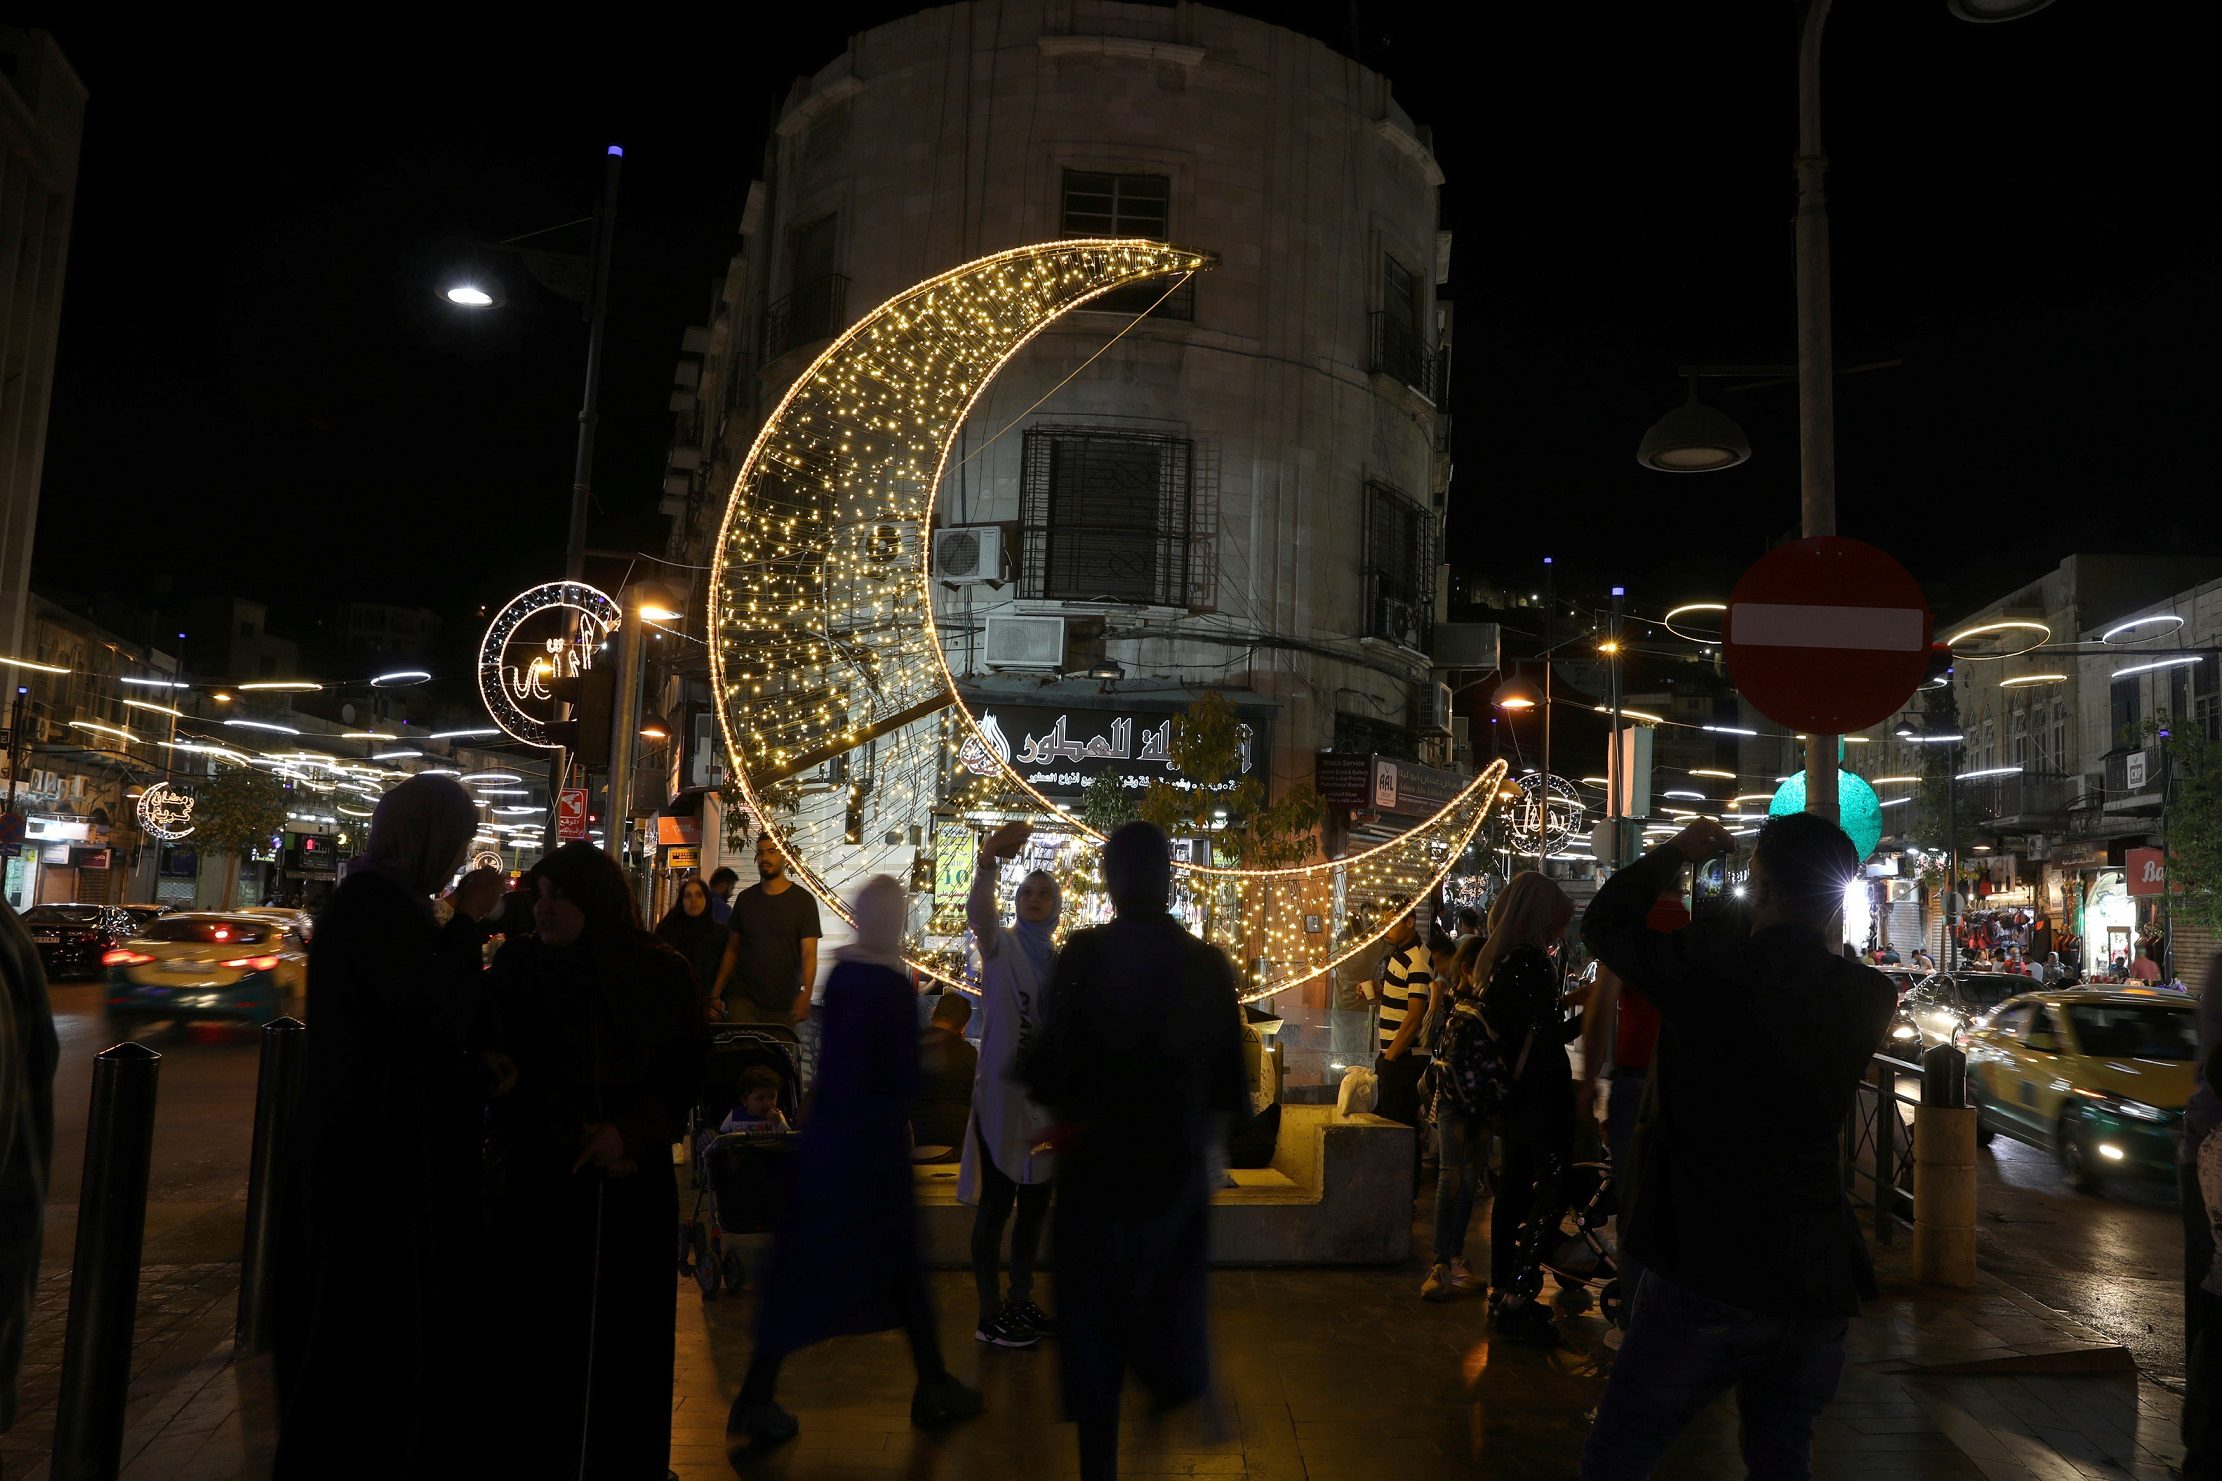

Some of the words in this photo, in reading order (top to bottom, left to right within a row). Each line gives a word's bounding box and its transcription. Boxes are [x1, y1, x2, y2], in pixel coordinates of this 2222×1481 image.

[1016, 714, 1132, 766] للعطور
[1026, 771, 1058, 784] العطور
[1379, 774, 1394, 792] AAL
[151, 791, 195, 808] رمضان
[151, 808, 192, 824] كريم
